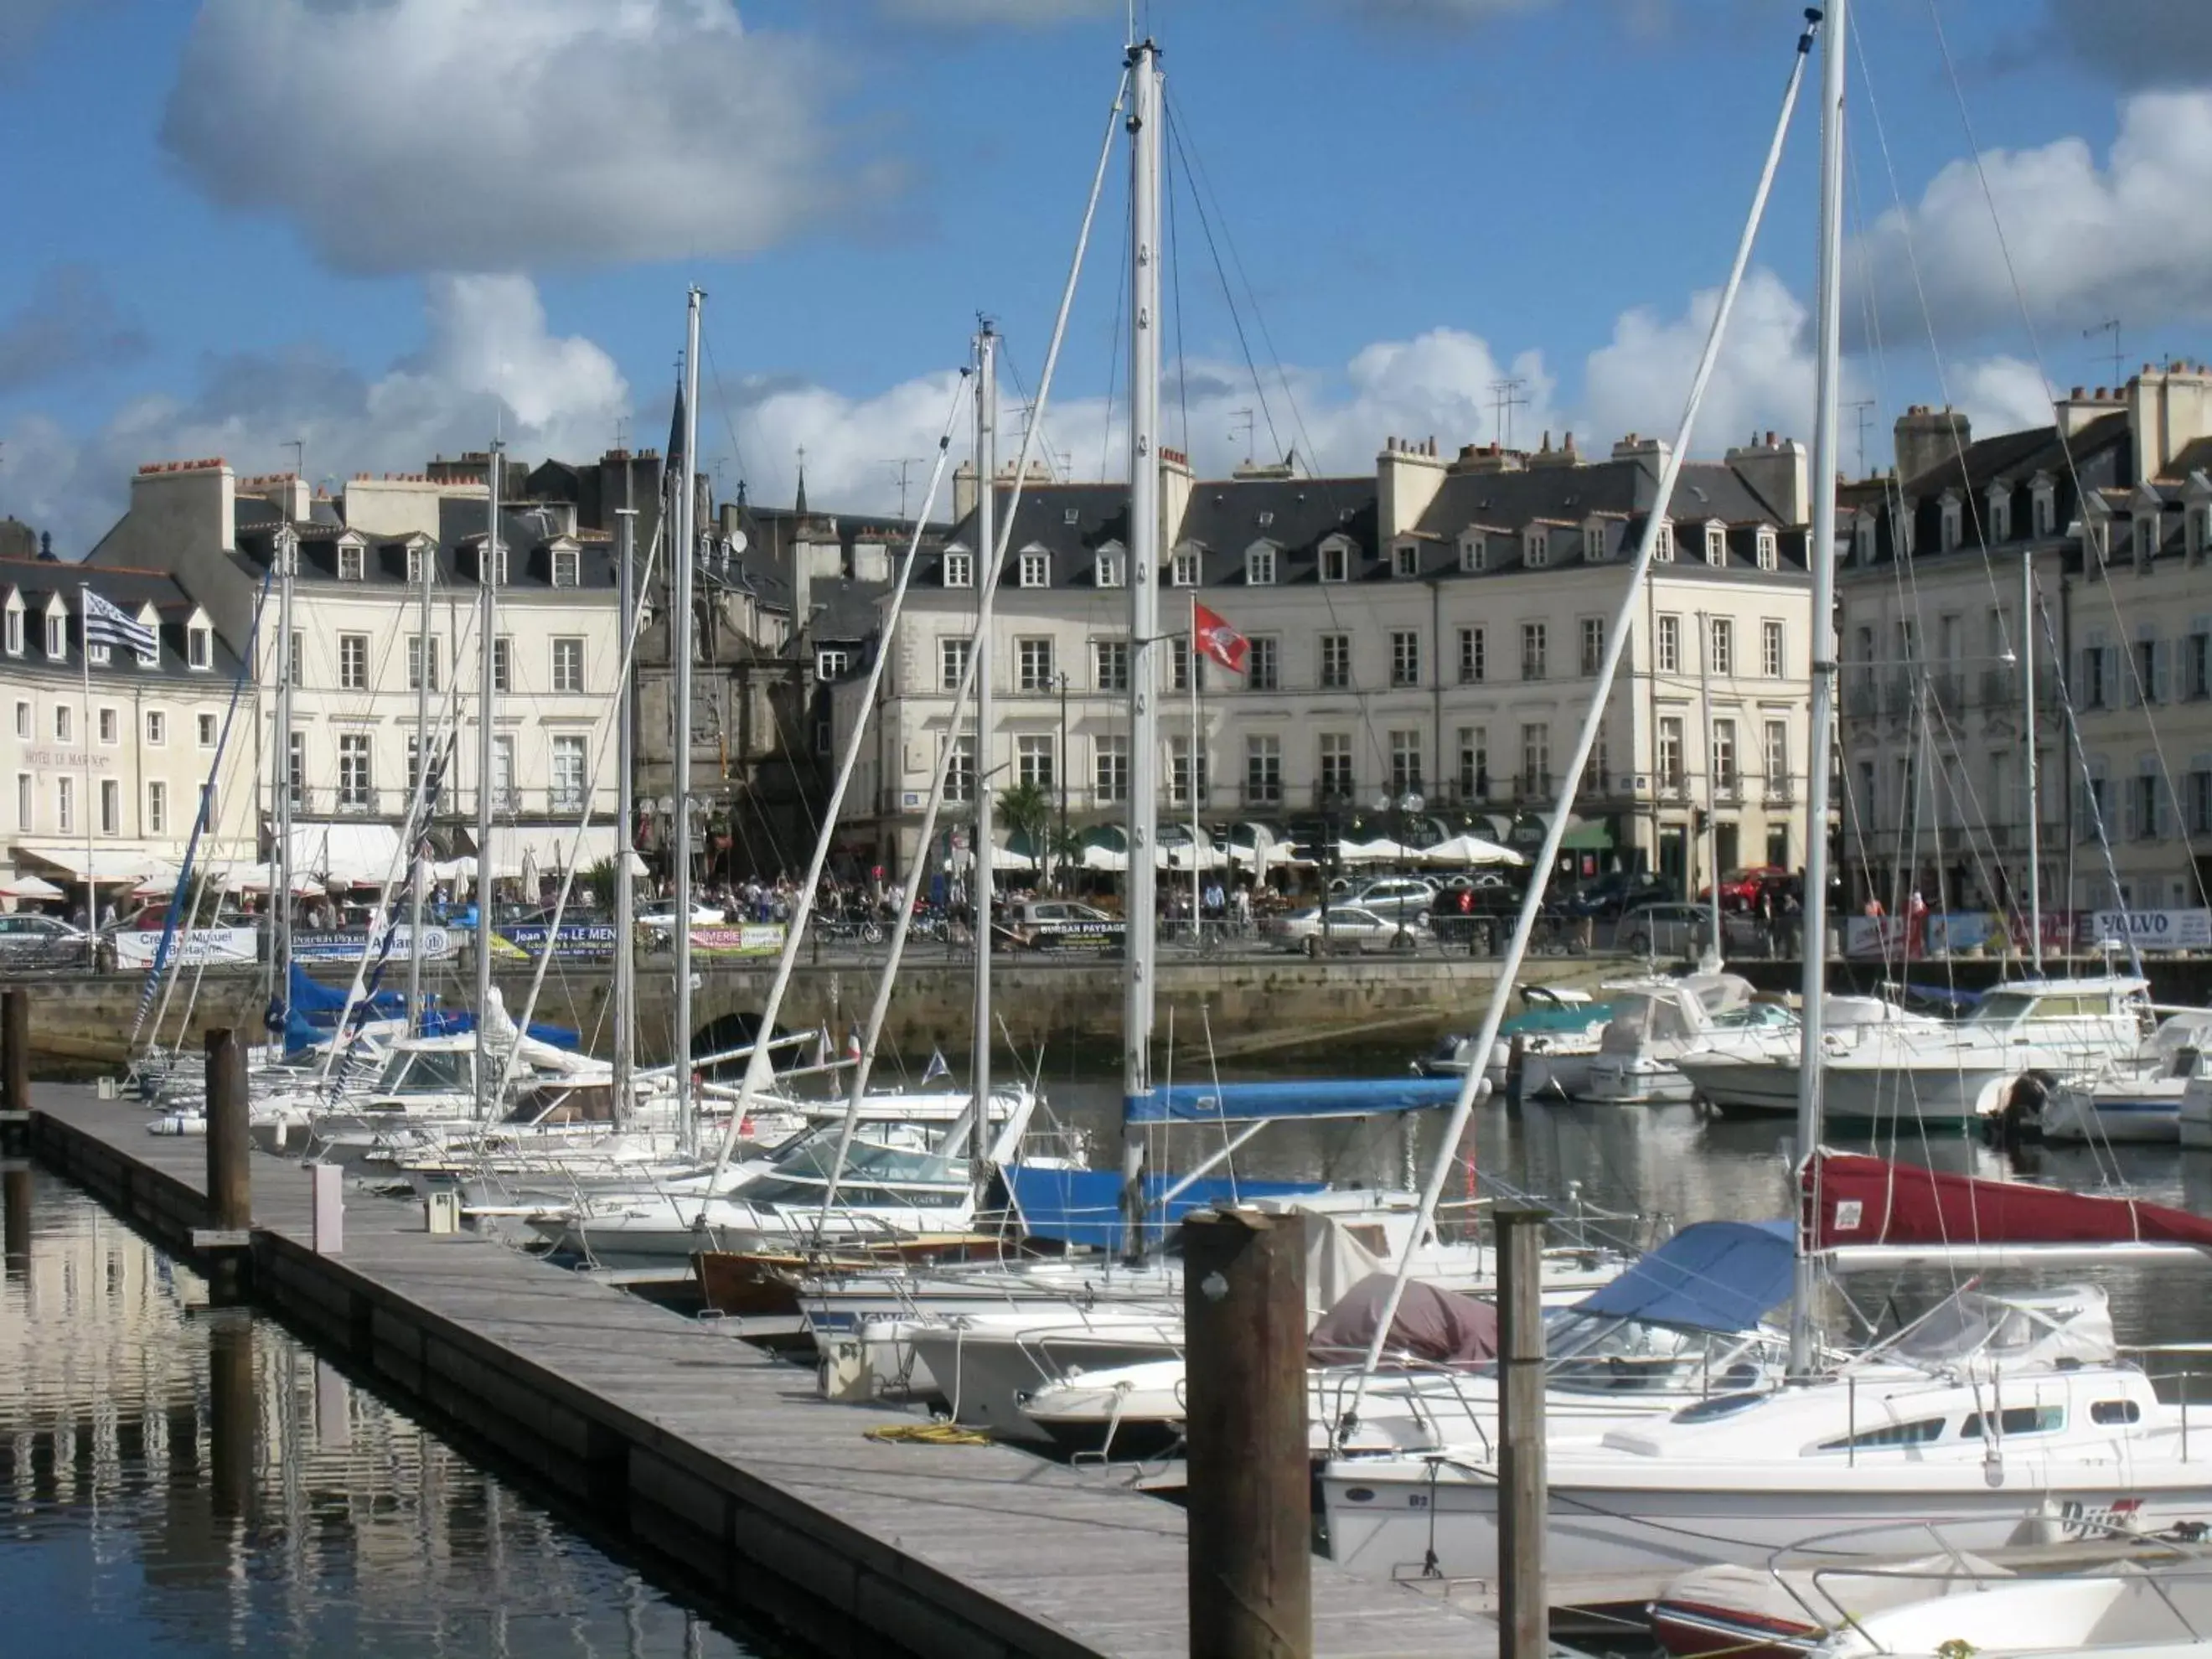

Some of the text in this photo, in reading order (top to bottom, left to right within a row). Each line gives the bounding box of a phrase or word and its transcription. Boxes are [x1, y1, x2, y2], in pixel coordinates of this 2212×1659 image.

[2101, 913, 2168, 933] VOLVO
[514, 929, 540, 943] Jean
[545, 928, 569, 939] Yes
[571, 928, 587, 940] LE
